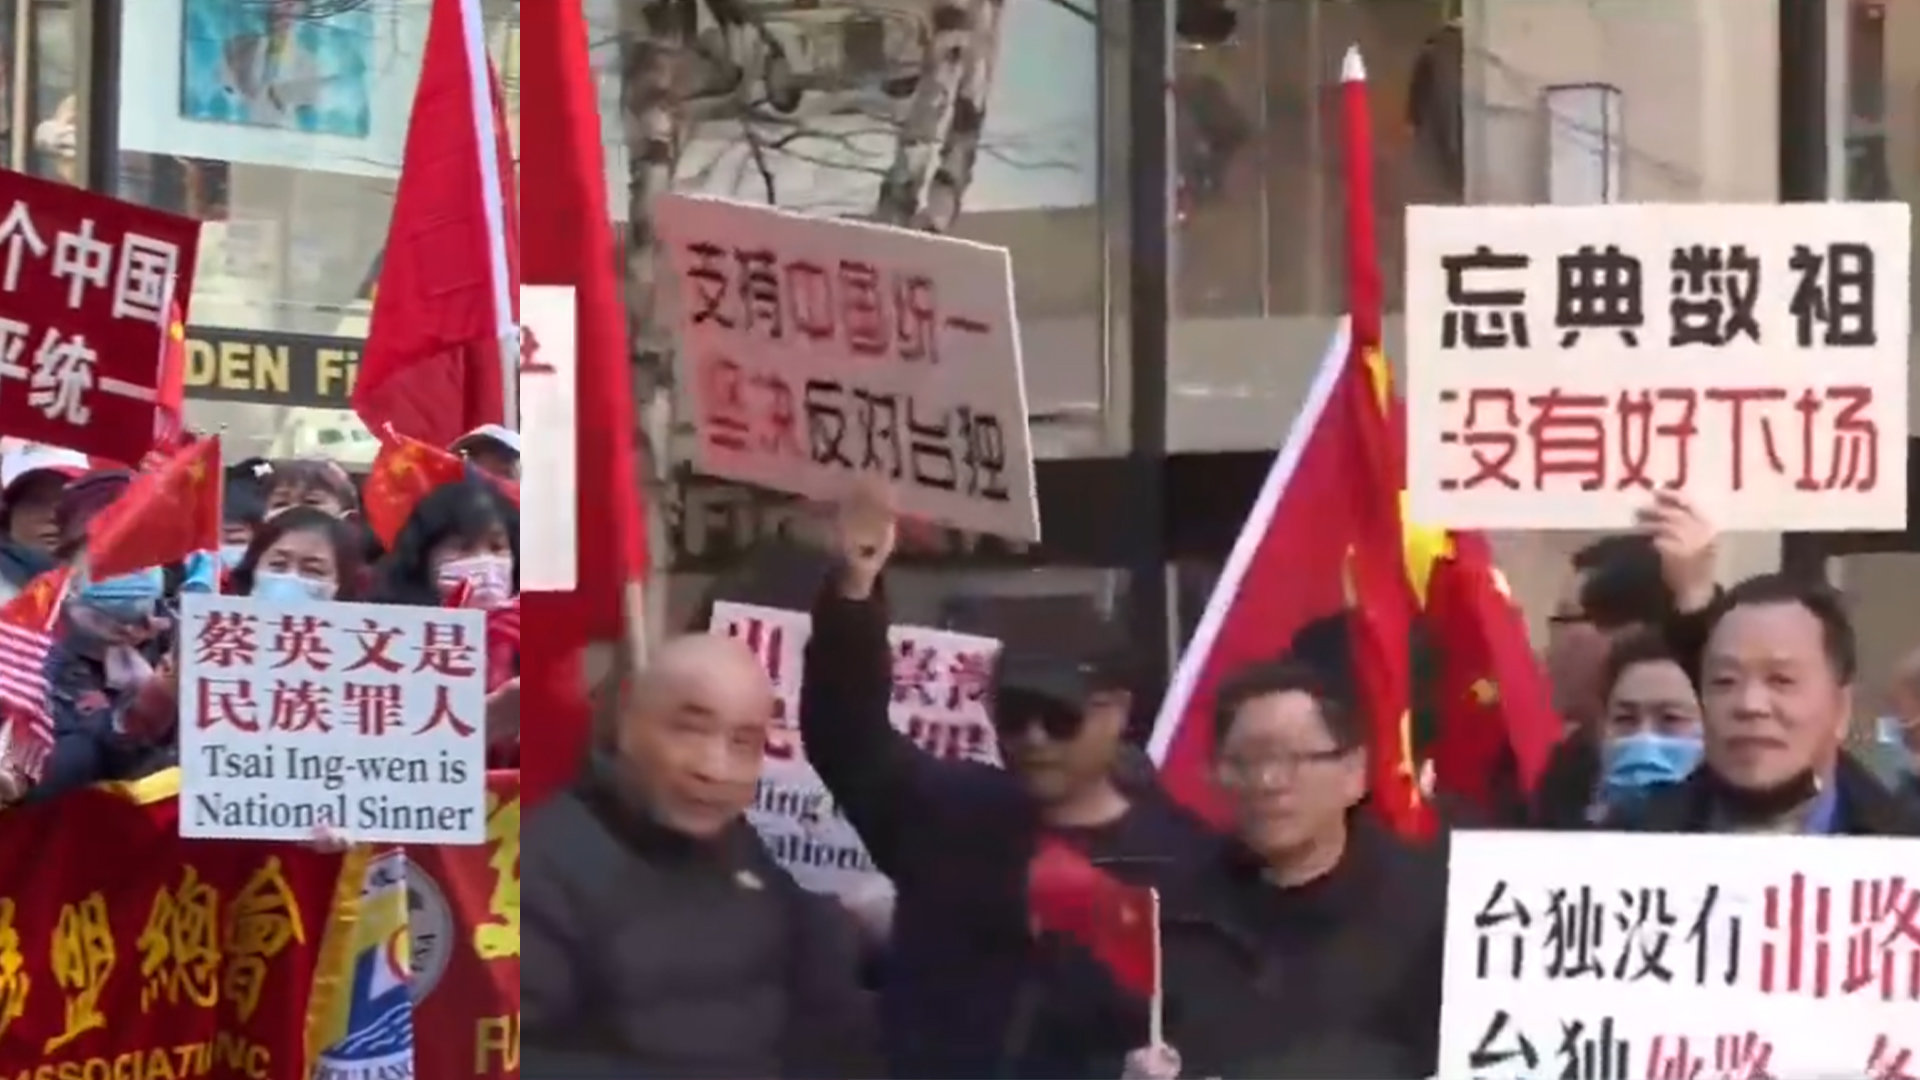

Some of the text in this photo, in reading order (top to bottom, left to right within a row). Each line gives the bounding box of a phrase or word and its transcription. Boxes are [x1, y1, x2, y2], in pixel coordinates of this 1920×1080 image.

[0, 200, 179, 327] 个中国
[1440, 243, 1878, 349] 忘典数祖
[1439, 387, 1879, 492] 没有好下场
[193, 610, 478, 678] 蔡英文是
[194, 676, 478, 738] 民族罪人
[201, 744, 468, 791] Tsai Ing-wen is
[195, 792, 475, 832] National Sinner
